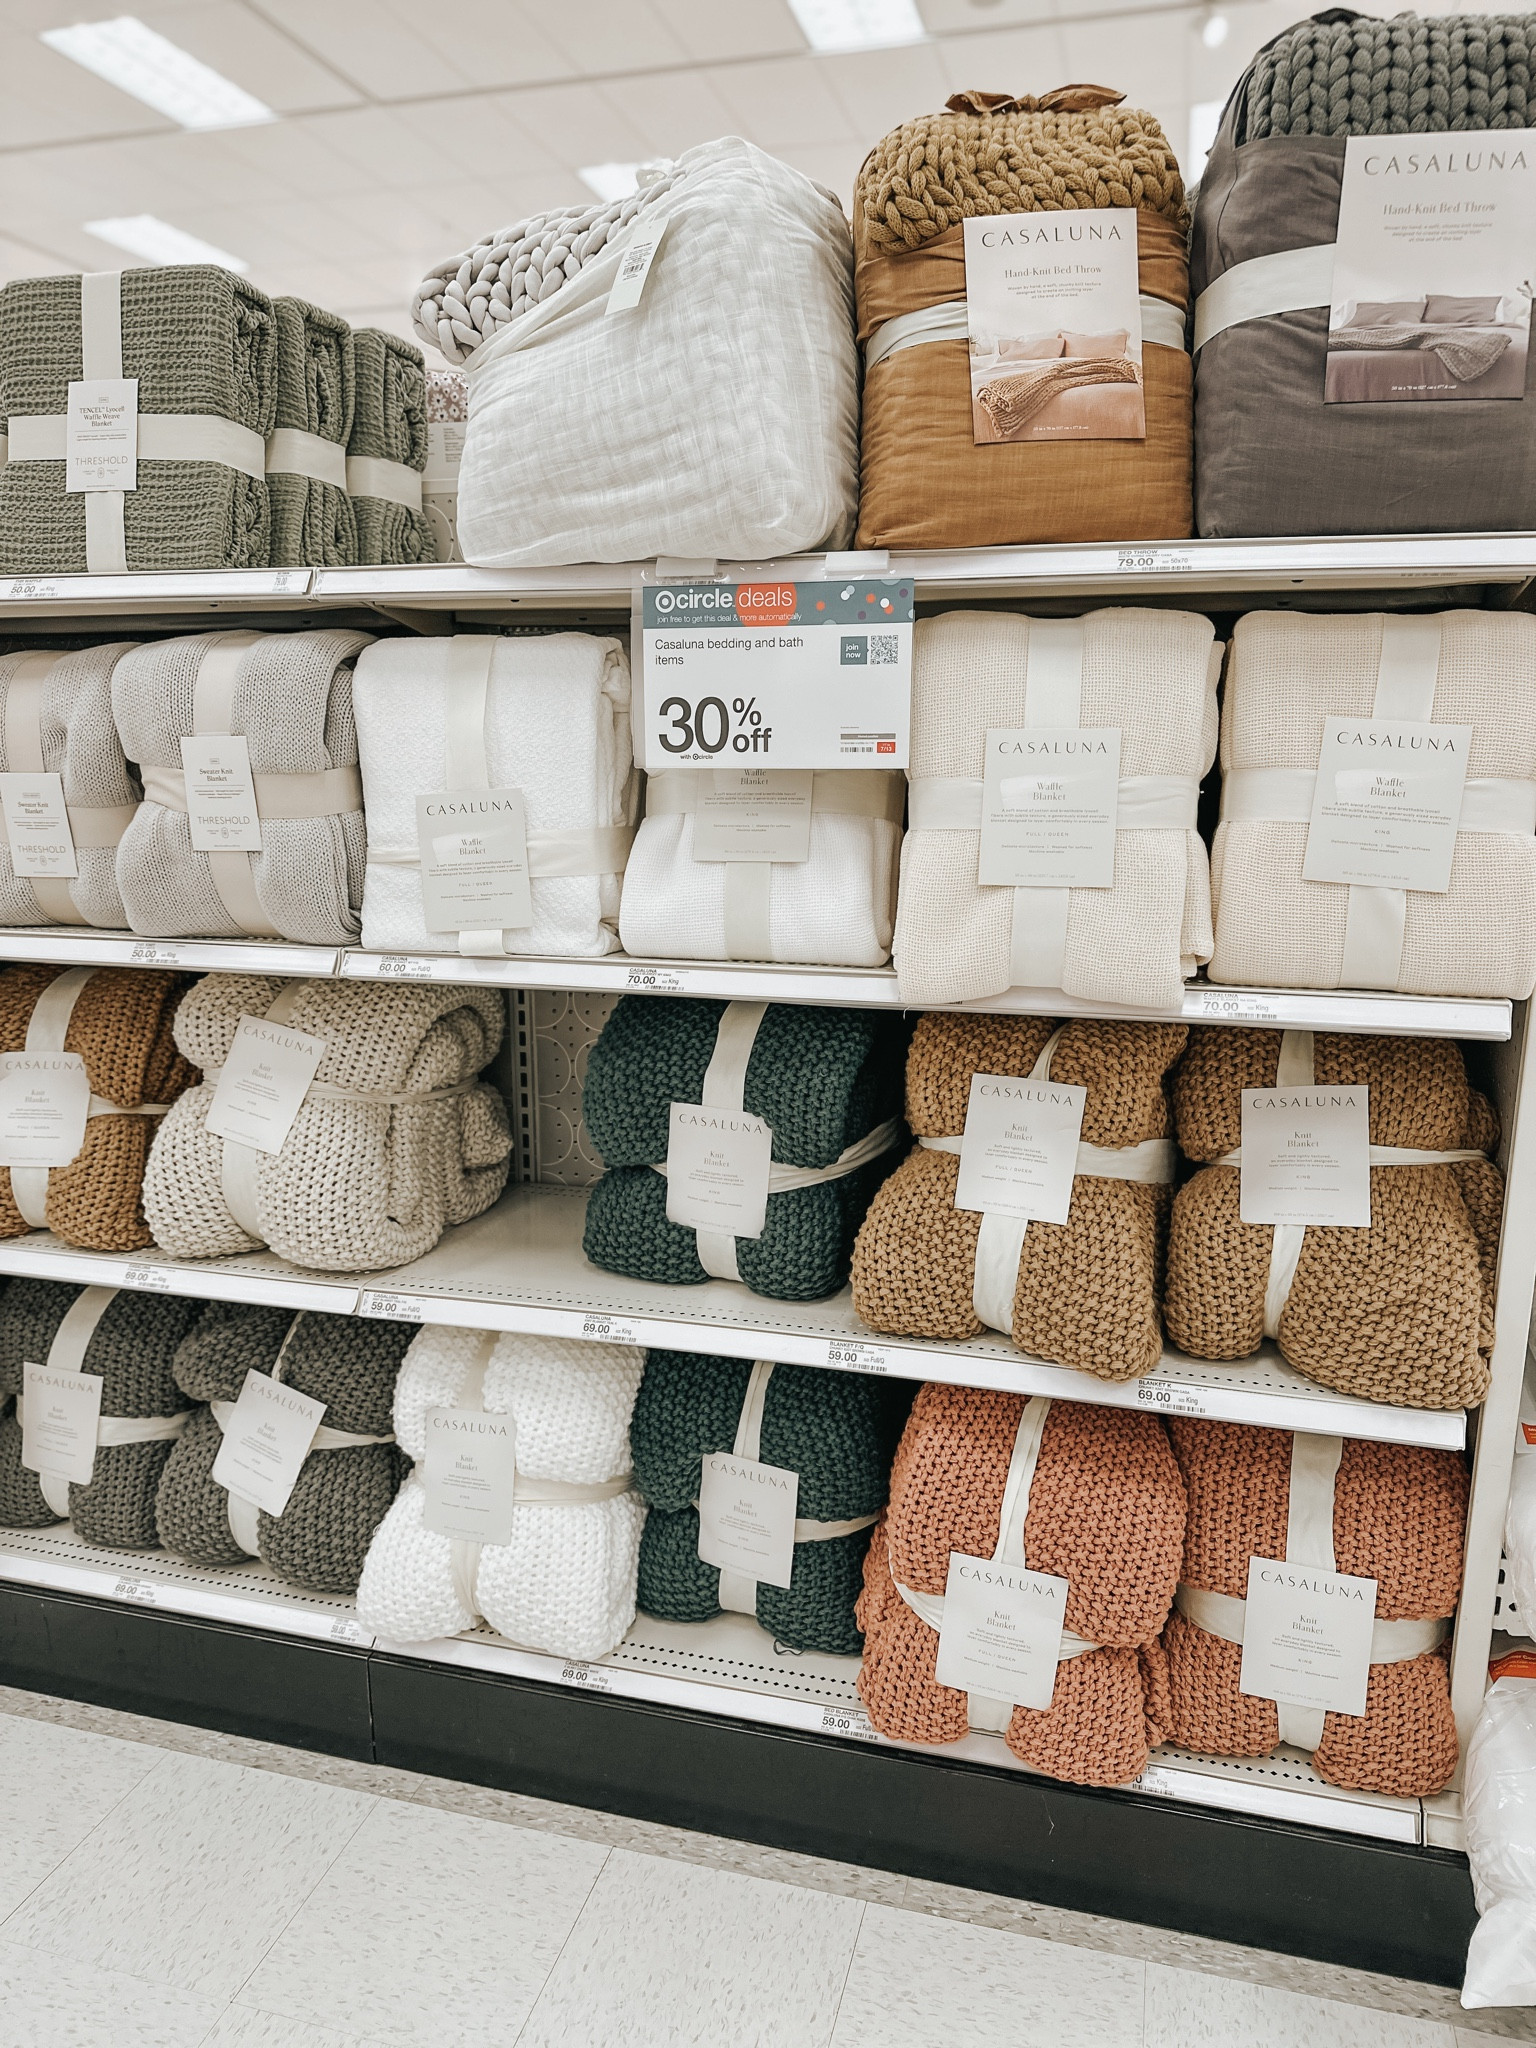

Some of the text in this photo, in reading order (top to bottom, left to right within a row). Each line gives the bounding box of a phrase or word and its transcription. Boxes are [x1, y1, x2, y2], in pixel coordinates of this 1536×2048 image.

[1364, 150, 1528, 176] CASALUNA
[1383, 201, 1497, 215] Hand-Knit Bed Throw
[982, 225, 1122, 248] CASALUNA
[1005, 264, 1102, 279] Hand-Knit Bed Throw
[106, 406, 125, 414] Lyocell
[75, 456, 128, 466] THRESHOLD
[1118, 557, 1154, 567] 79.00
[11, 586, 35, 594] 50.00
[675, 586, 793, 609] circle deals
[656, 612, 802, 625] join free to get this deal & more automatically
[655, 636, 804, 650] Casaluna bedding and bath
[845, 643, 859, 652] join
[655, 655, 684, 665] items
[845, 651, 861, 659] now
[732, 727, 773, 753] off
[1336, 731, 1456, 752] CASALUNA
[998, 741, 1108, 754] CASALUNA
[1037, 782, 1064, 791] Waffle
[1375, 776, 1405, 788] Waffle
[1033, 792, 1066, 801] Blanket
[1370, 786, 1407, 799] Blanket
[426, 800, 513, 816] CASALUNA
[197, 815, 250, 825] THRESHOLD
[461, 838, 483, 846] Waffle
[17, 845, 66, 854] THRESHOLD
[459, 847, 486, 856] Blanket
[131, 950, 157, 958] 50.00
[379, 963, 406, 972] 60.00
[627, 975, 656, 985] 70.00
[1203, 1001, 1269, 1012] 70.00 King
[243, 1025, 313, 1056] CASALUNA
[5, 1060, 84, 1071] CASALUNA
[980, 1084, 1073, 1107] CASALUNA
[1252, 1096, 1356, 1109] CASALUNA
[679, 1113, 763, 1135] CASALUNA
[1011, 1123, 1028, 1132] Knit
[1004, 1131, 1033, 1141] Blanket
[1294, 1131, 1312, 1139] Knit
[1287, 1139, 1319, 1148] Blanket
[709, 1150, 725, 1159] Knit
[125, 1271, 149, 1282] 69.00
[370, 1301, 397, 1312] 59.00
[583, 1322, 632, 1336] 69.00 King
[829, 1340, 854, 1349] BLANKET
[828, 1350, 858, 1363] 59.00
[29, 1372, 95, 1394] CASALUNA
[1138, 1379, 1166, 1388] BLANKET
[250, 1381, 314, 1420] CASALUNA
[1138, 1389, 1199, 1406] 69.00 King
[433, 1417, 507, 1436] CASALUNA
[710, 1460, 788, 1490] CASALUNA
[959, 1566, 1056, 1599] CASALUNA
[1260, 1570, 1364, 1601] CASALUNA
[115, 1583, 138, 1595] 69.00
[994, 1610, 1011, 1621] Knit
[1299, 1614, 1317, 1625] Knit
[986, 1617, 1016, 1631] Blanket
[1292, 1621, 1324, 1635] Blanket
[562, 1668, 588, 1681] 69.00
[835, 1709, 859, 1718] BLANKET
[822, 1715, 850, 1729] 59.00
